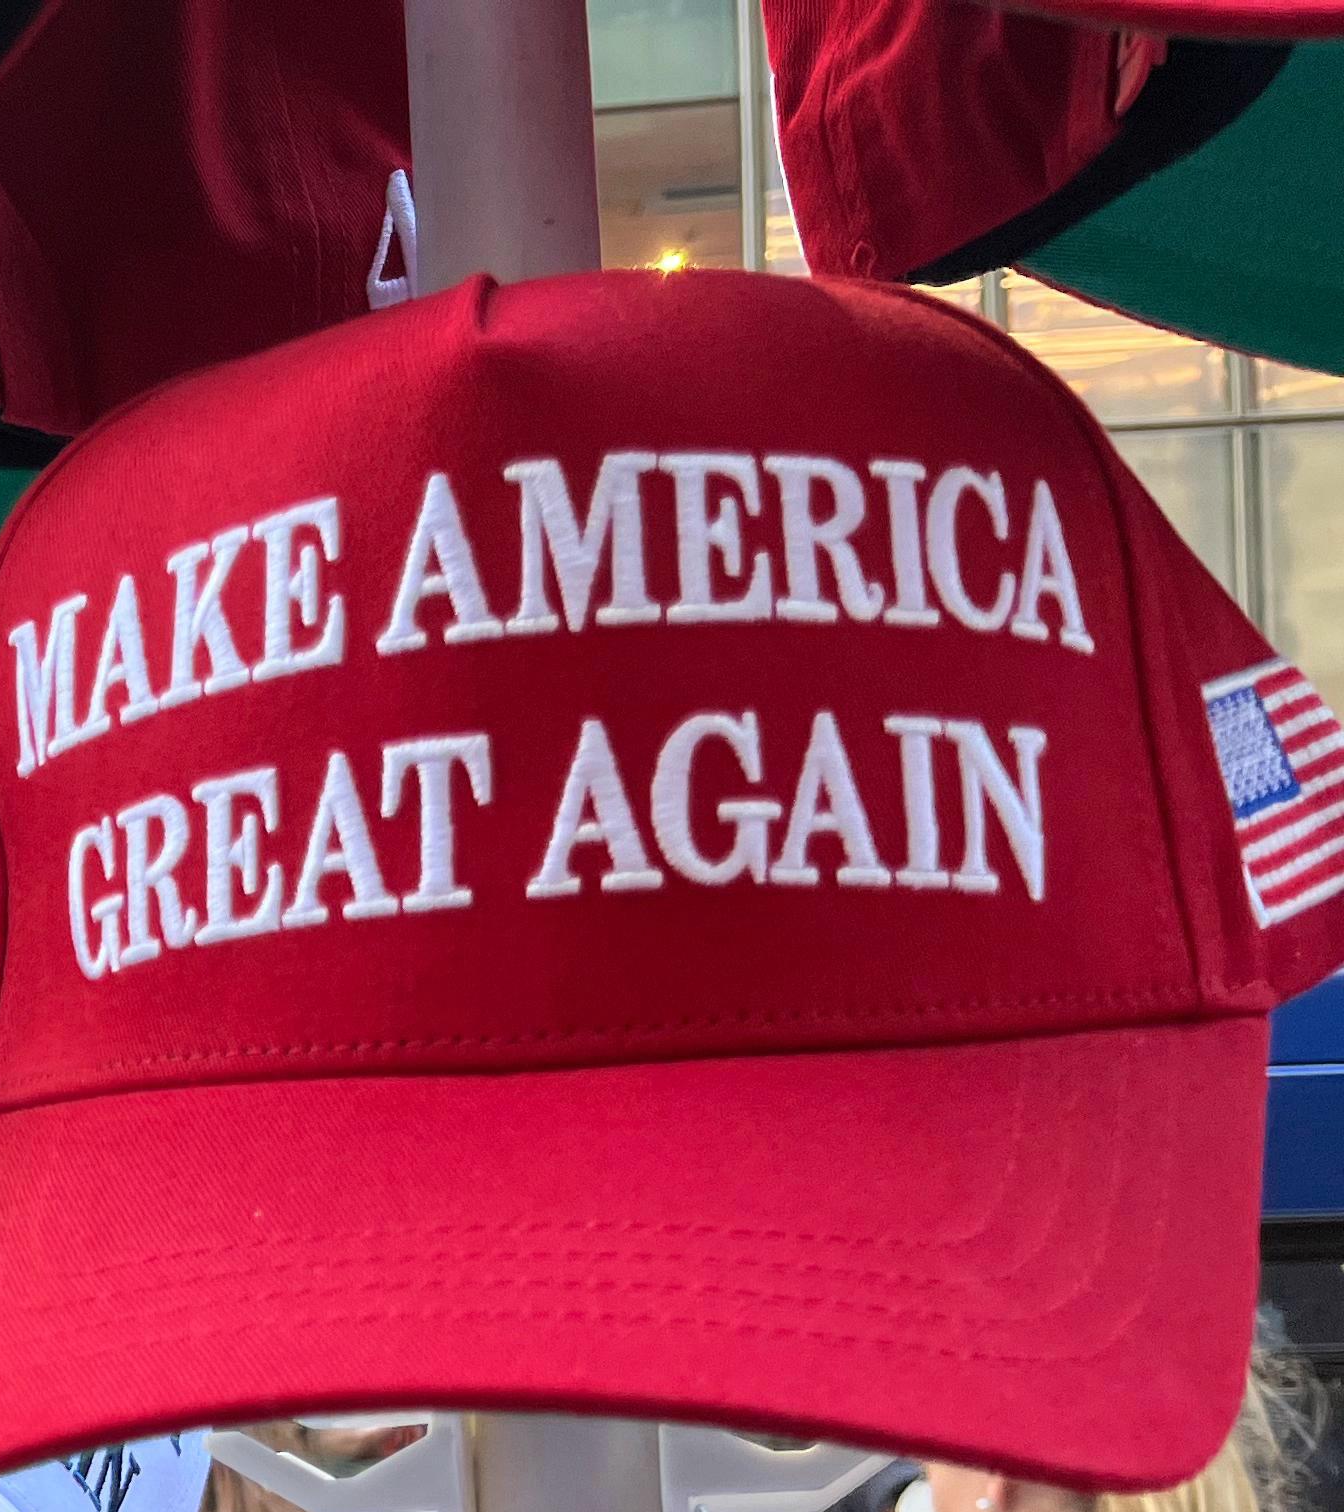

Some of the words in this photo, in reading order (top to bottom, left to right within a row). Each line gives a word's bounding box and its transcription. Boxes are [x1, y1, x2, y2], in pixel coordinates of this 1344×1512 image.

[7, 496, 348, 779] MAKE
[375, 451, 1095, 654] AMERICA
[66, 732, 492, 981] GREAT
[526, 710, 1049, 903] AGAIN
